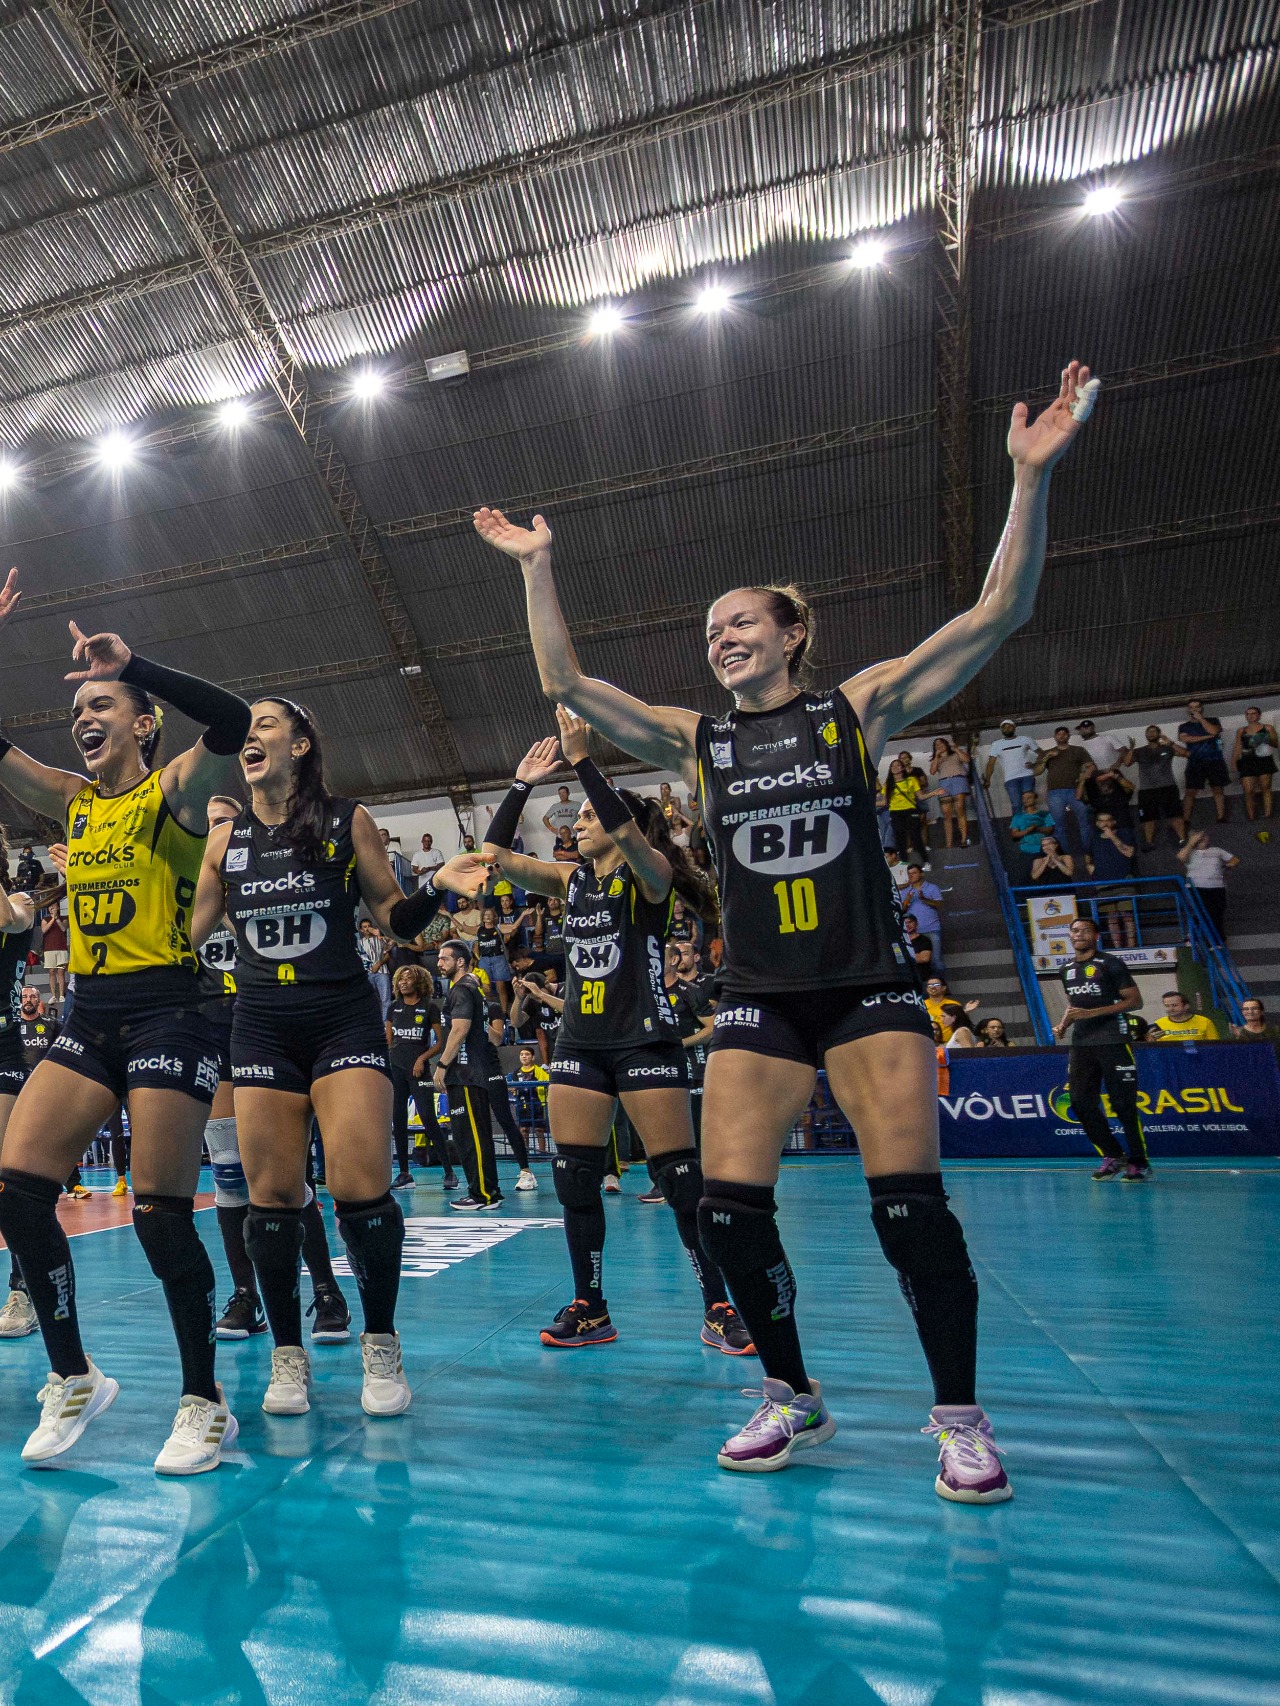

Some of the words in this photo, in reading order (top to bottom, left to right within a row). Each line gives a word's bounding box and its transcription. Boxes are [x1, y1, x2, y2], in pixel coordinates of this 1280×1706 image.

[727, 761, 832, 795] crock's
[806, 778, 834, 788] CLUB
[722, 796, 852, 826] SUPERMERCADOS
[750, 813, 830, 865] BH
[68, 843, 135, 867] crock's
[241, 870, 316, 896] crock's
[294, 886, 316, 894] CLUB
[79, 892, 124, 926] BH
[236, 899, 331, 919] SUPERMERCADOS
[774, 878, 819, 934] 10
[255, 914, 313, 949] BH
[91, 942, 108, 976] 2
[575, 946, 613, 969] BH
[581, 980, 606, 1015] 20
[714, 1007, 760, 1025] entil
[23, 1037, 49, 1046] rock's
[392, 1026, 424, 1036] Dentil
[127, 1054, 183, 1074] crock's
[330, 1053, 385, 1068] crock's
[550, 1060, 580, 1071] entil
[938, 1092, 1046, 1121] VÔLEI
[1143, 1124, 1185, 1132] ASILEIRA
[589, 1251, 601, 1289] Dentil
[48, 1264, 70, 1321] Dentil
